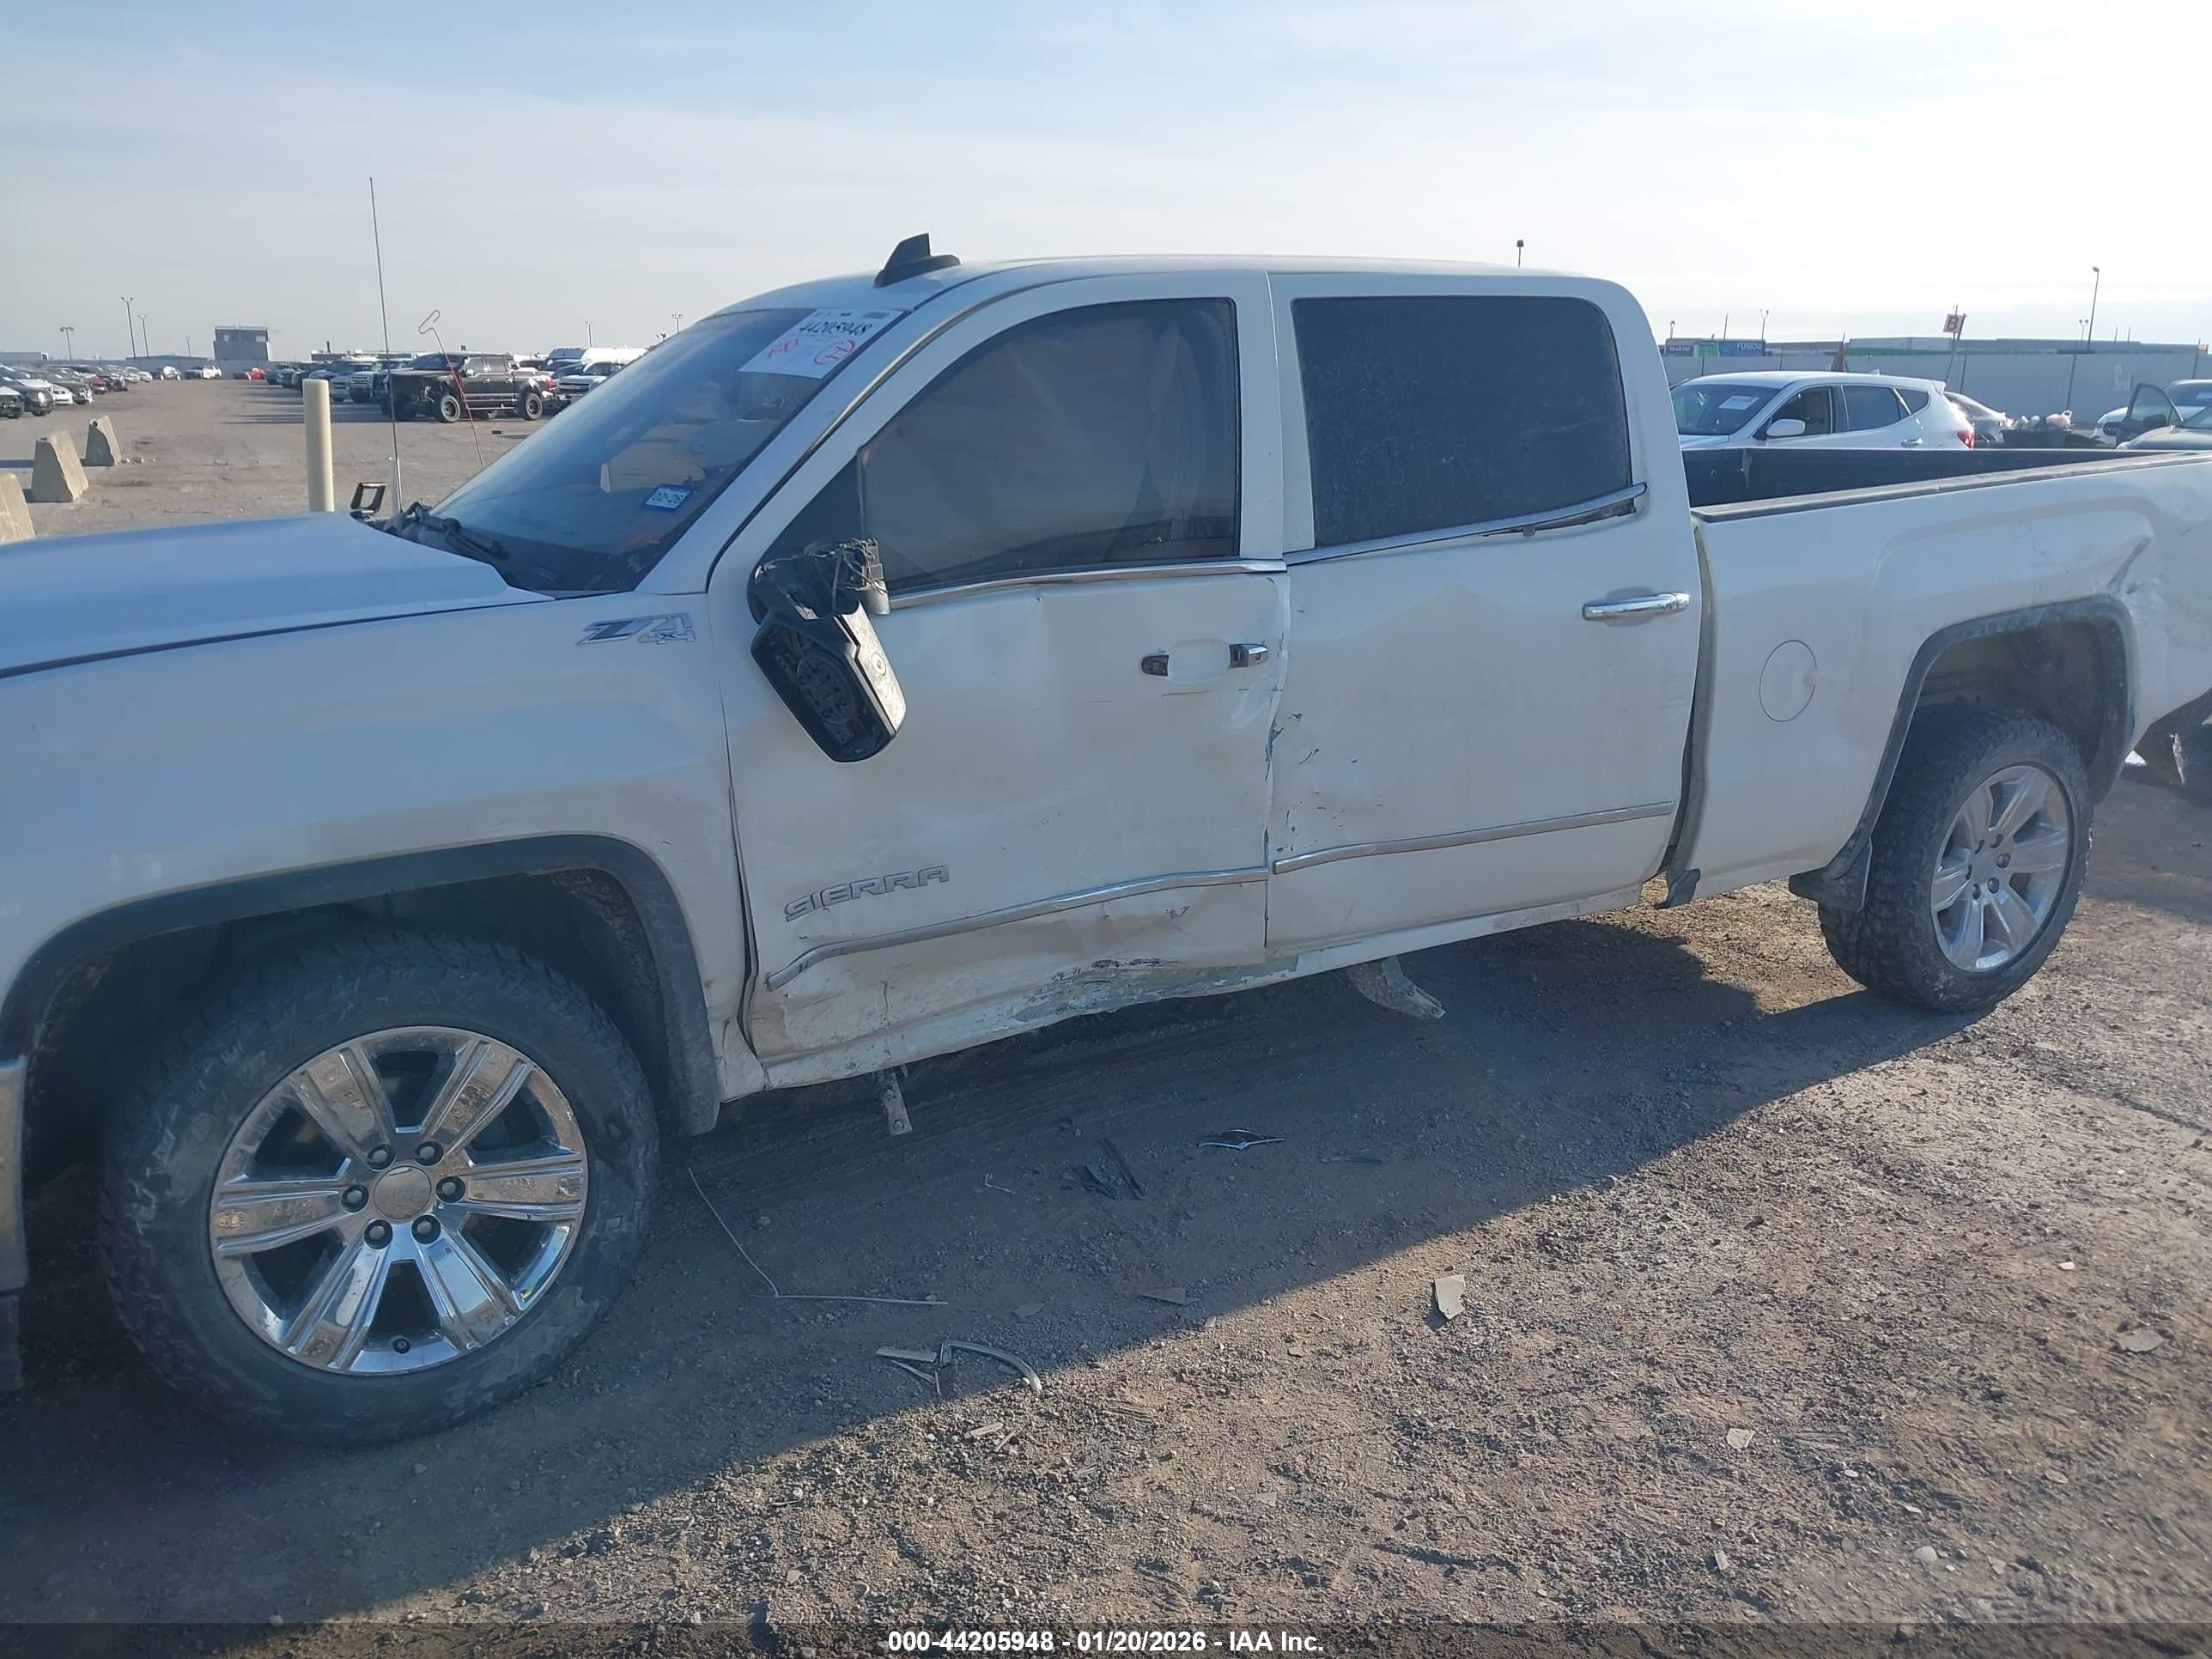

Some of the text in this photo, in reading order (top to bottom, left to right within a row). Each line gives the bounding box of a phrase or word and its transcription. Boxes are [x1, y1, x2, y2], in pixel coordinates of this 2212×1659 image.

[1946, 316, 1960, 331] B
[1736, 343, 1763, 351] FUSION
[576, 612, 693, 646] Z71
[784, 865, 951, 922] SIERRA
